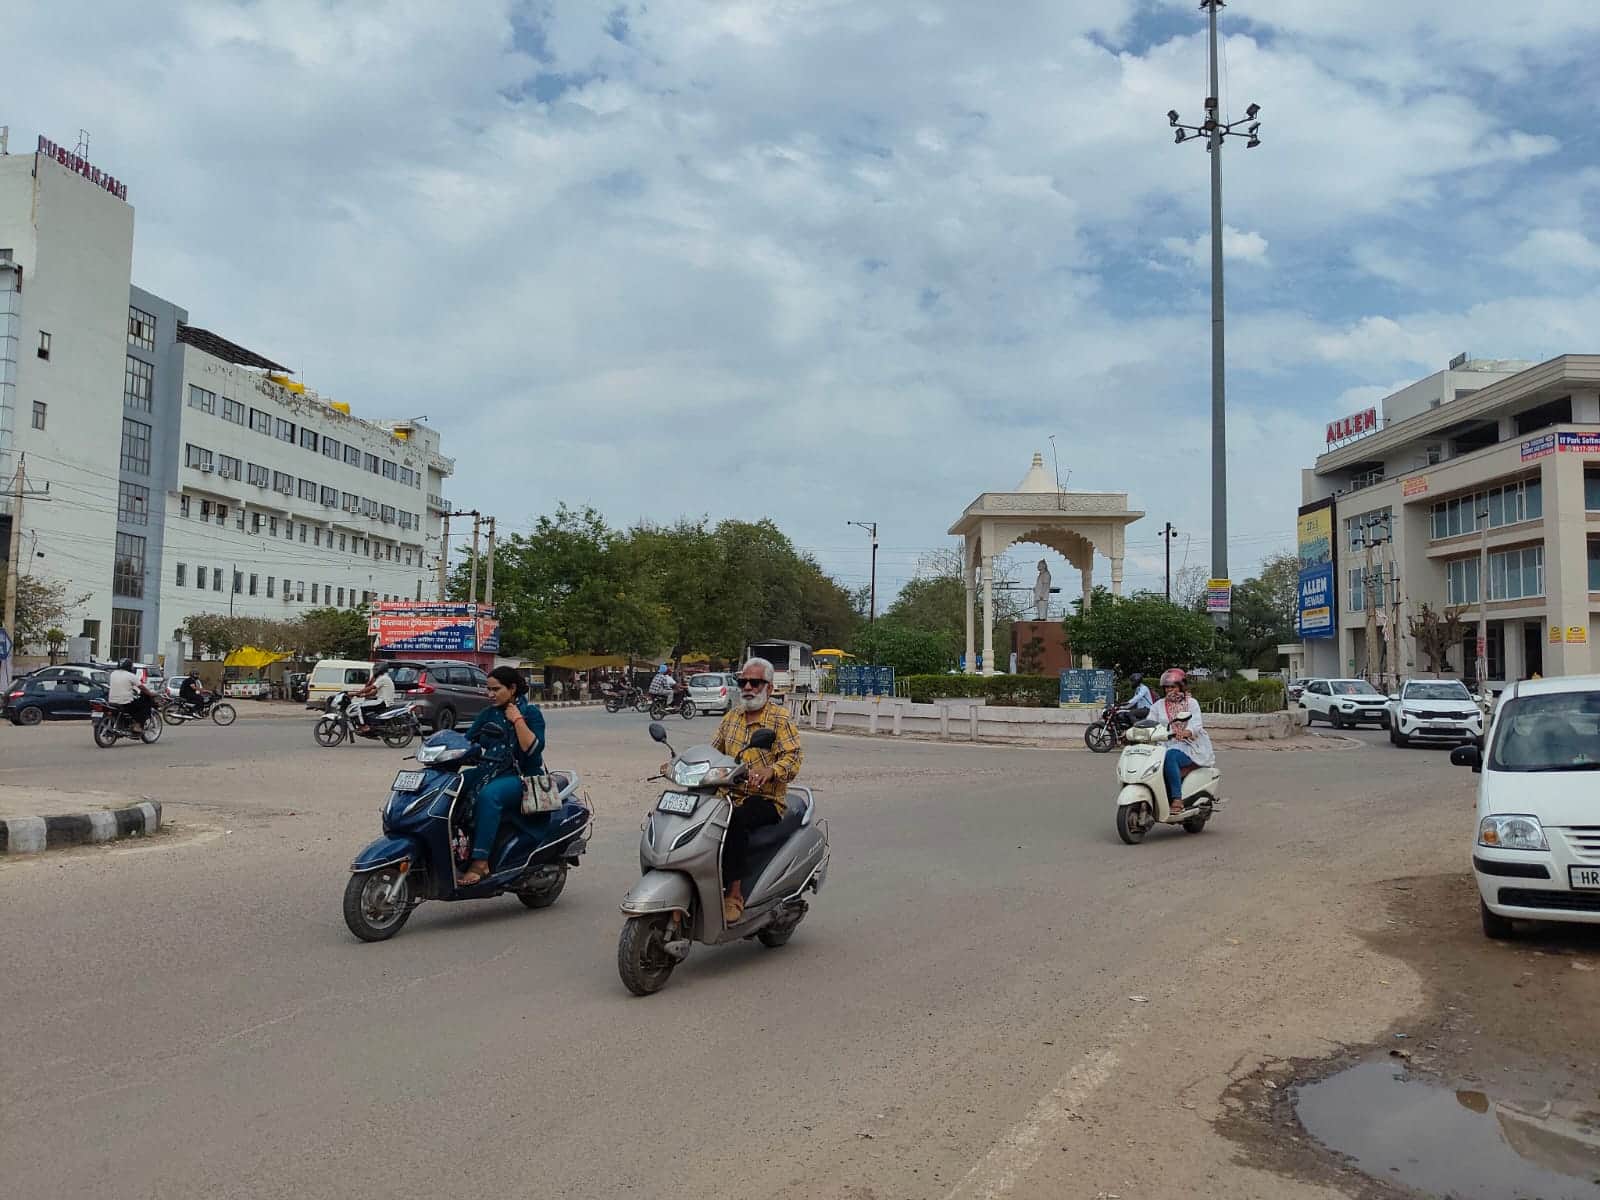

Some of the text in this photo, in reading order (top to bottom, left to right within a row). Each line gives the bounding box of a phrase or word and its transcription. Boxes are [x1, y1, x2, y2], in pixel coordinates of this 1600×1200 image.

[38, 134, 127, 201] PUSHPANJALI
[1326, 408, 1375, 443] ALLEN
[1566, 435, 1581, 444] Park
[1302, 576, 1327, 596] ALLEN
[1581, 871, 1600, 885] HR
